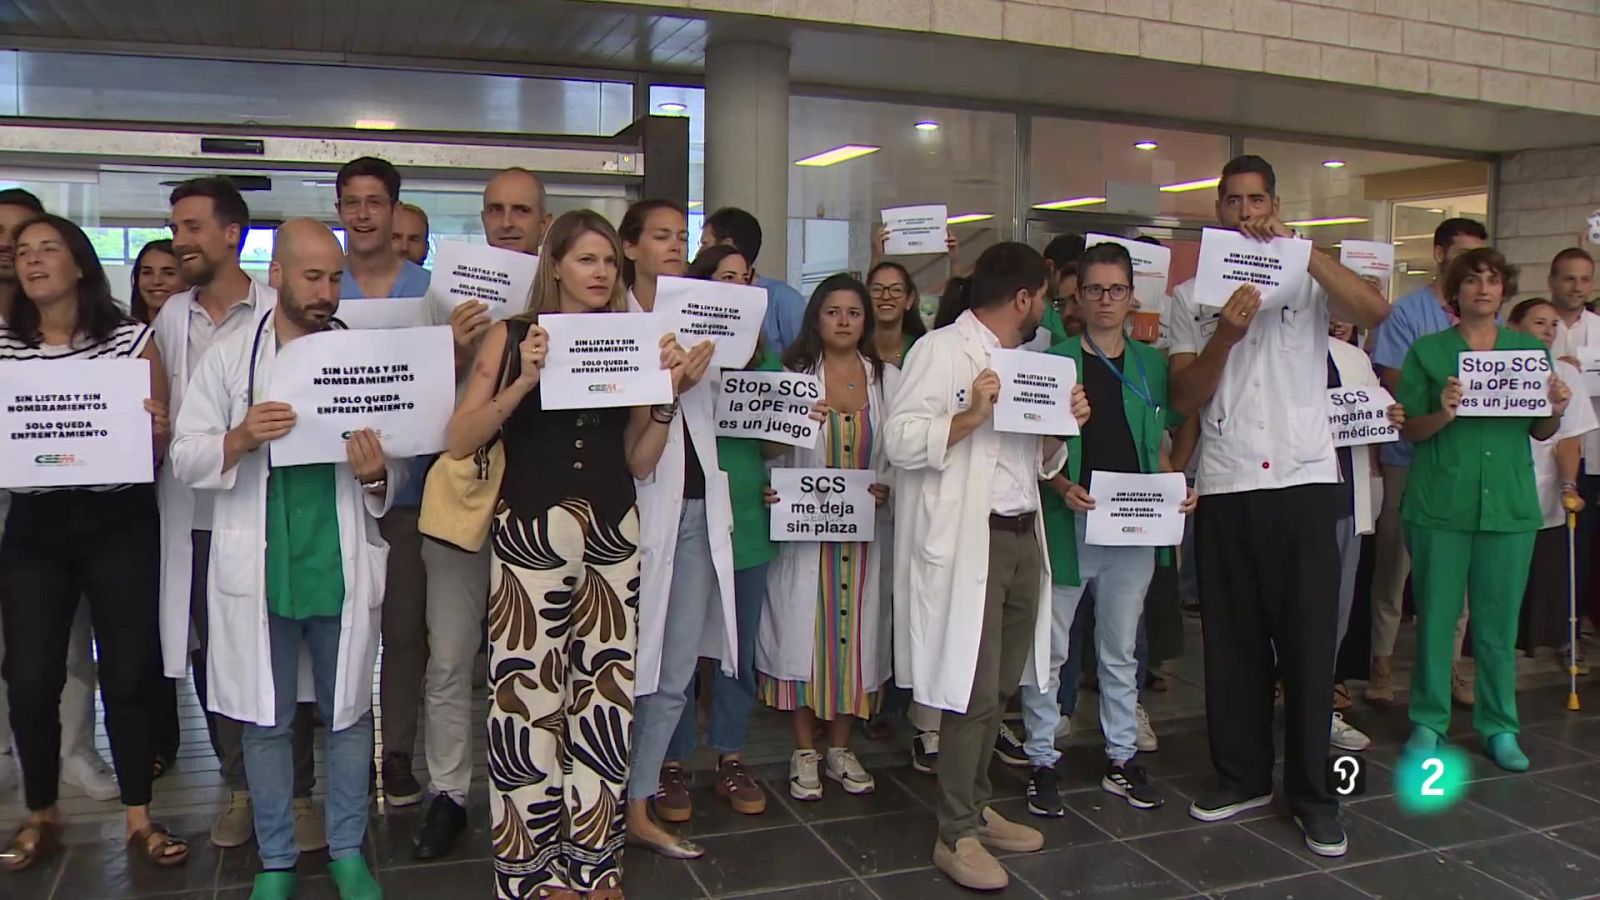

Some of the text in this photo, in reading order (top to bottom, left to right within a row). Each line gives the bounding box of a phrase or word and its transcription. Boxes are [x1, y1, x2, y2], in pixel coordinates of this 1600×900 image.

[1250, 271, 1271, 279] QUEDA
[602, 359, 629, 367] QUEDA
[1462, 357, 1549, 375] Stop SCS
[322, 367, 341, 375] SIN
[343, 366, 381, 375] LISTAS
[391, 364, 409, 373] SIN
[313, 374, 415, 385] NOMBRAMIENTOS
[1470, 379, 1541, 390] la OPE no
[724, 378, 819, 399] Stop SCS
[14, 395, 33, 403] SIN
[35, 394, 72, 402] LISTAS
[83, 393, 101, 401] SIN
[333, 394, 401, 404] SOLO QUEDA
[1330, 391, 1369, 406] SCS
[1462, 396, 1547, 410] es un juego
[7, 403, 108, 412] NOMBRAMIENTOS
[317, 402, 415, 414] ENFRENTAMIENTO
[729, 399, 809, 415] la OPE no
[1376, 409, 1384, 418] a
[25, 421, 93, 430] SOLO QUEDA
[719, 417, 812, 439] es un juego
[11, 430, 108, 440] ENFRENTAMIENTO
[1338, 425, 1395, 440] médicos
[801, 476, 846, 494] SCS
[791, 501, 854, 518] me deja
[786, 520, 857, 536] sin plaza
